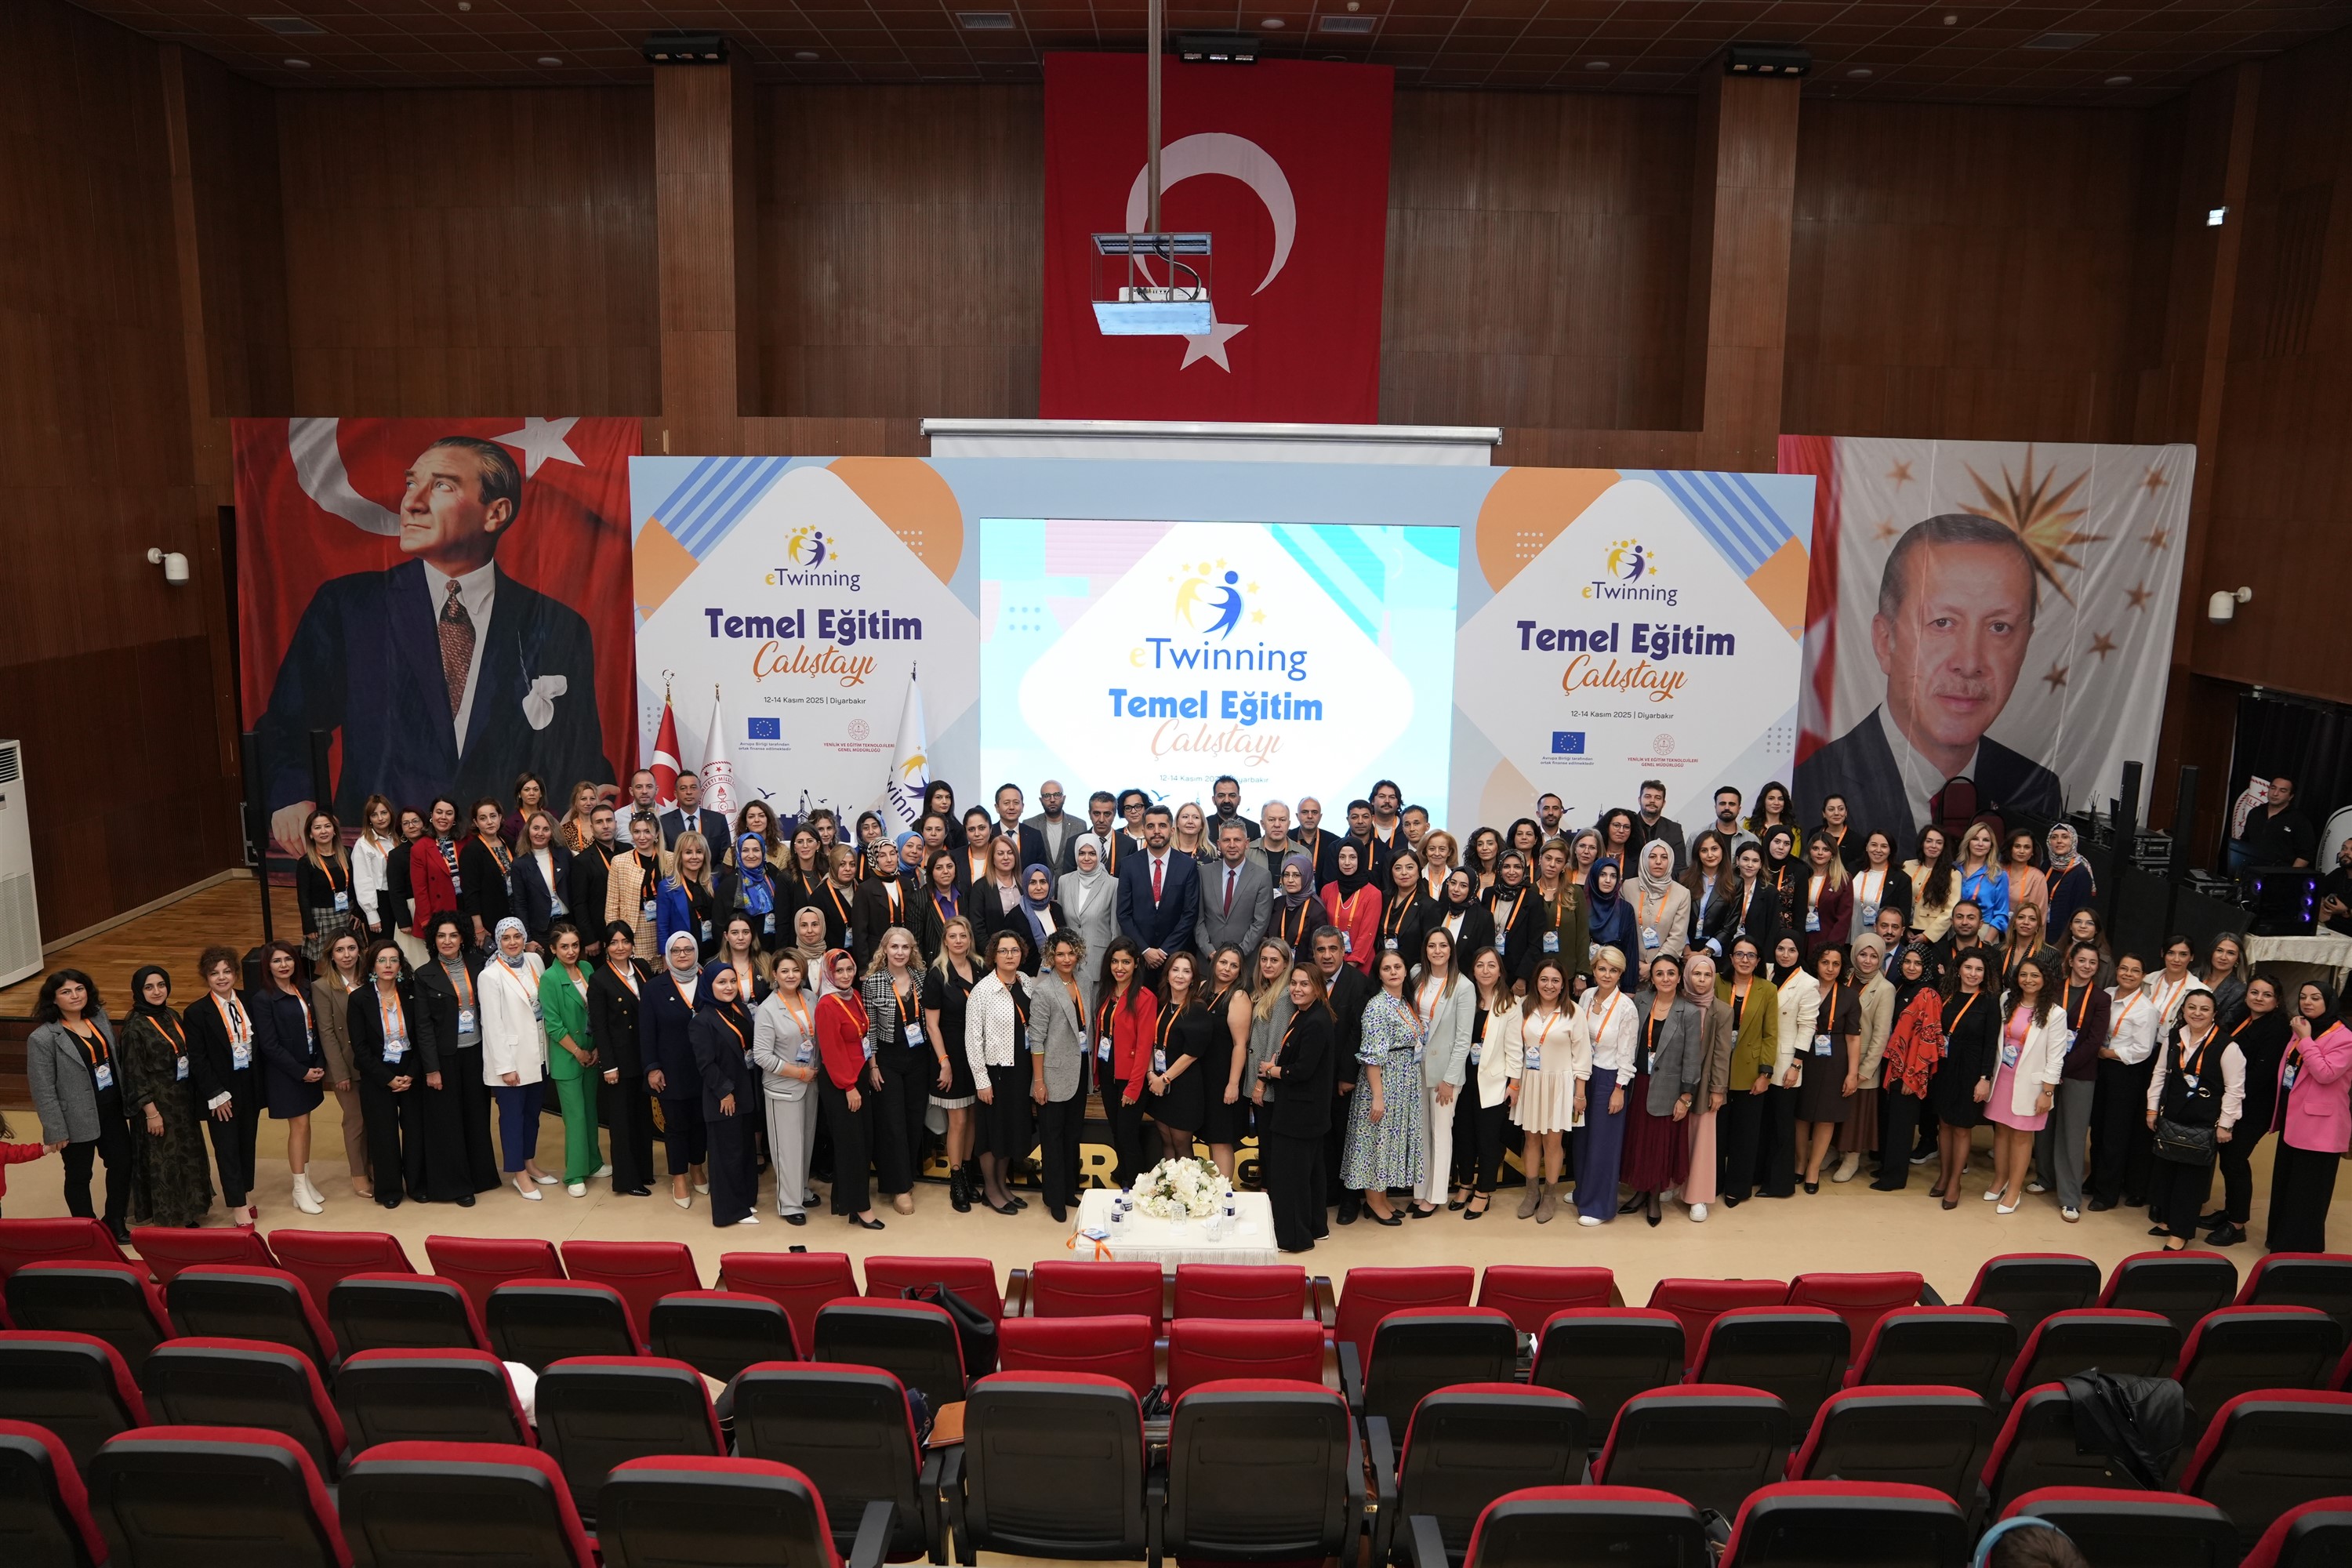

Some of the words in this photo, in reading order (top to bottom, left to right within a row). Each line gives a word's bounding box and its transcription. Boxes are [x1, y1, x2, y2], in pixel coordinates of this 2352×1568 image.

[765, 568, 860, 591] eTwinning
[1582, 582, 1678, 606] eTwinning
[705, 608, 804, 639] Temel
[818, 609, 921, 646] Eğitim
[1517, 621, 1619, 652] Temel
[1632, 623, 1736, 660] Eğitim
[753, 641, 877, 688] Çalıştayı
[1130, 637, 1308, 681] eTwinning
[1562, 654, 1688, 702] Çalıştayı
[1109, 688, 1207, 719] Temel
[1221, 691, 1323, 726] Eğitim
[1151, 718, 1284, 767] Çalıştayı
